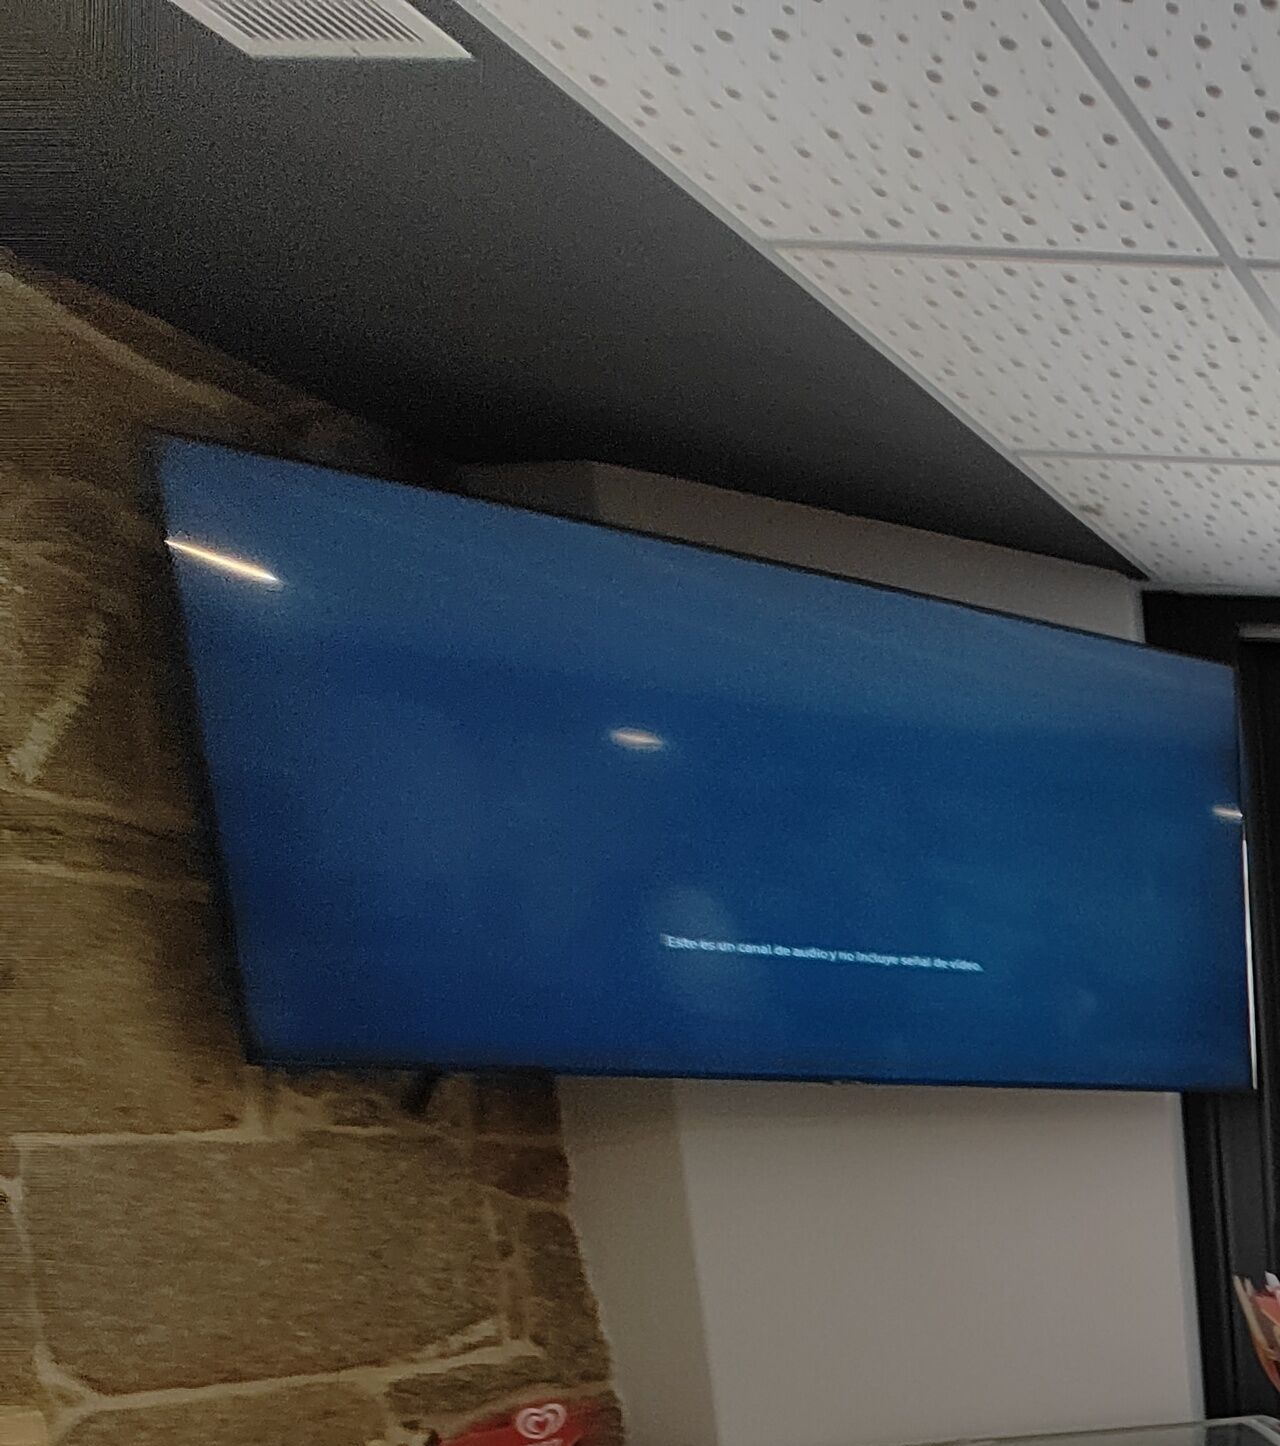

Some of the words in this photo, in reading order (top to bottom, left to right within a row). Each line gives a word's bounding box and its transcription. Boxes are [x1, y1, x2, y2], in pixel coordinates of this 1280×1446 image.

[667, 935, 698, 949] Este
[700, 940, 716, 951] es
[716, 942, 736, 951] un
[739, 943, 773, 955] canal
[774, 945, 791, 956] de
[792, 947, 829, 960] audio
[829, 950, 838, 962] y
[838, 952, 855, 962] no
[856, 952, 900, 966] incluye
[933, 957, 950, 969] de
